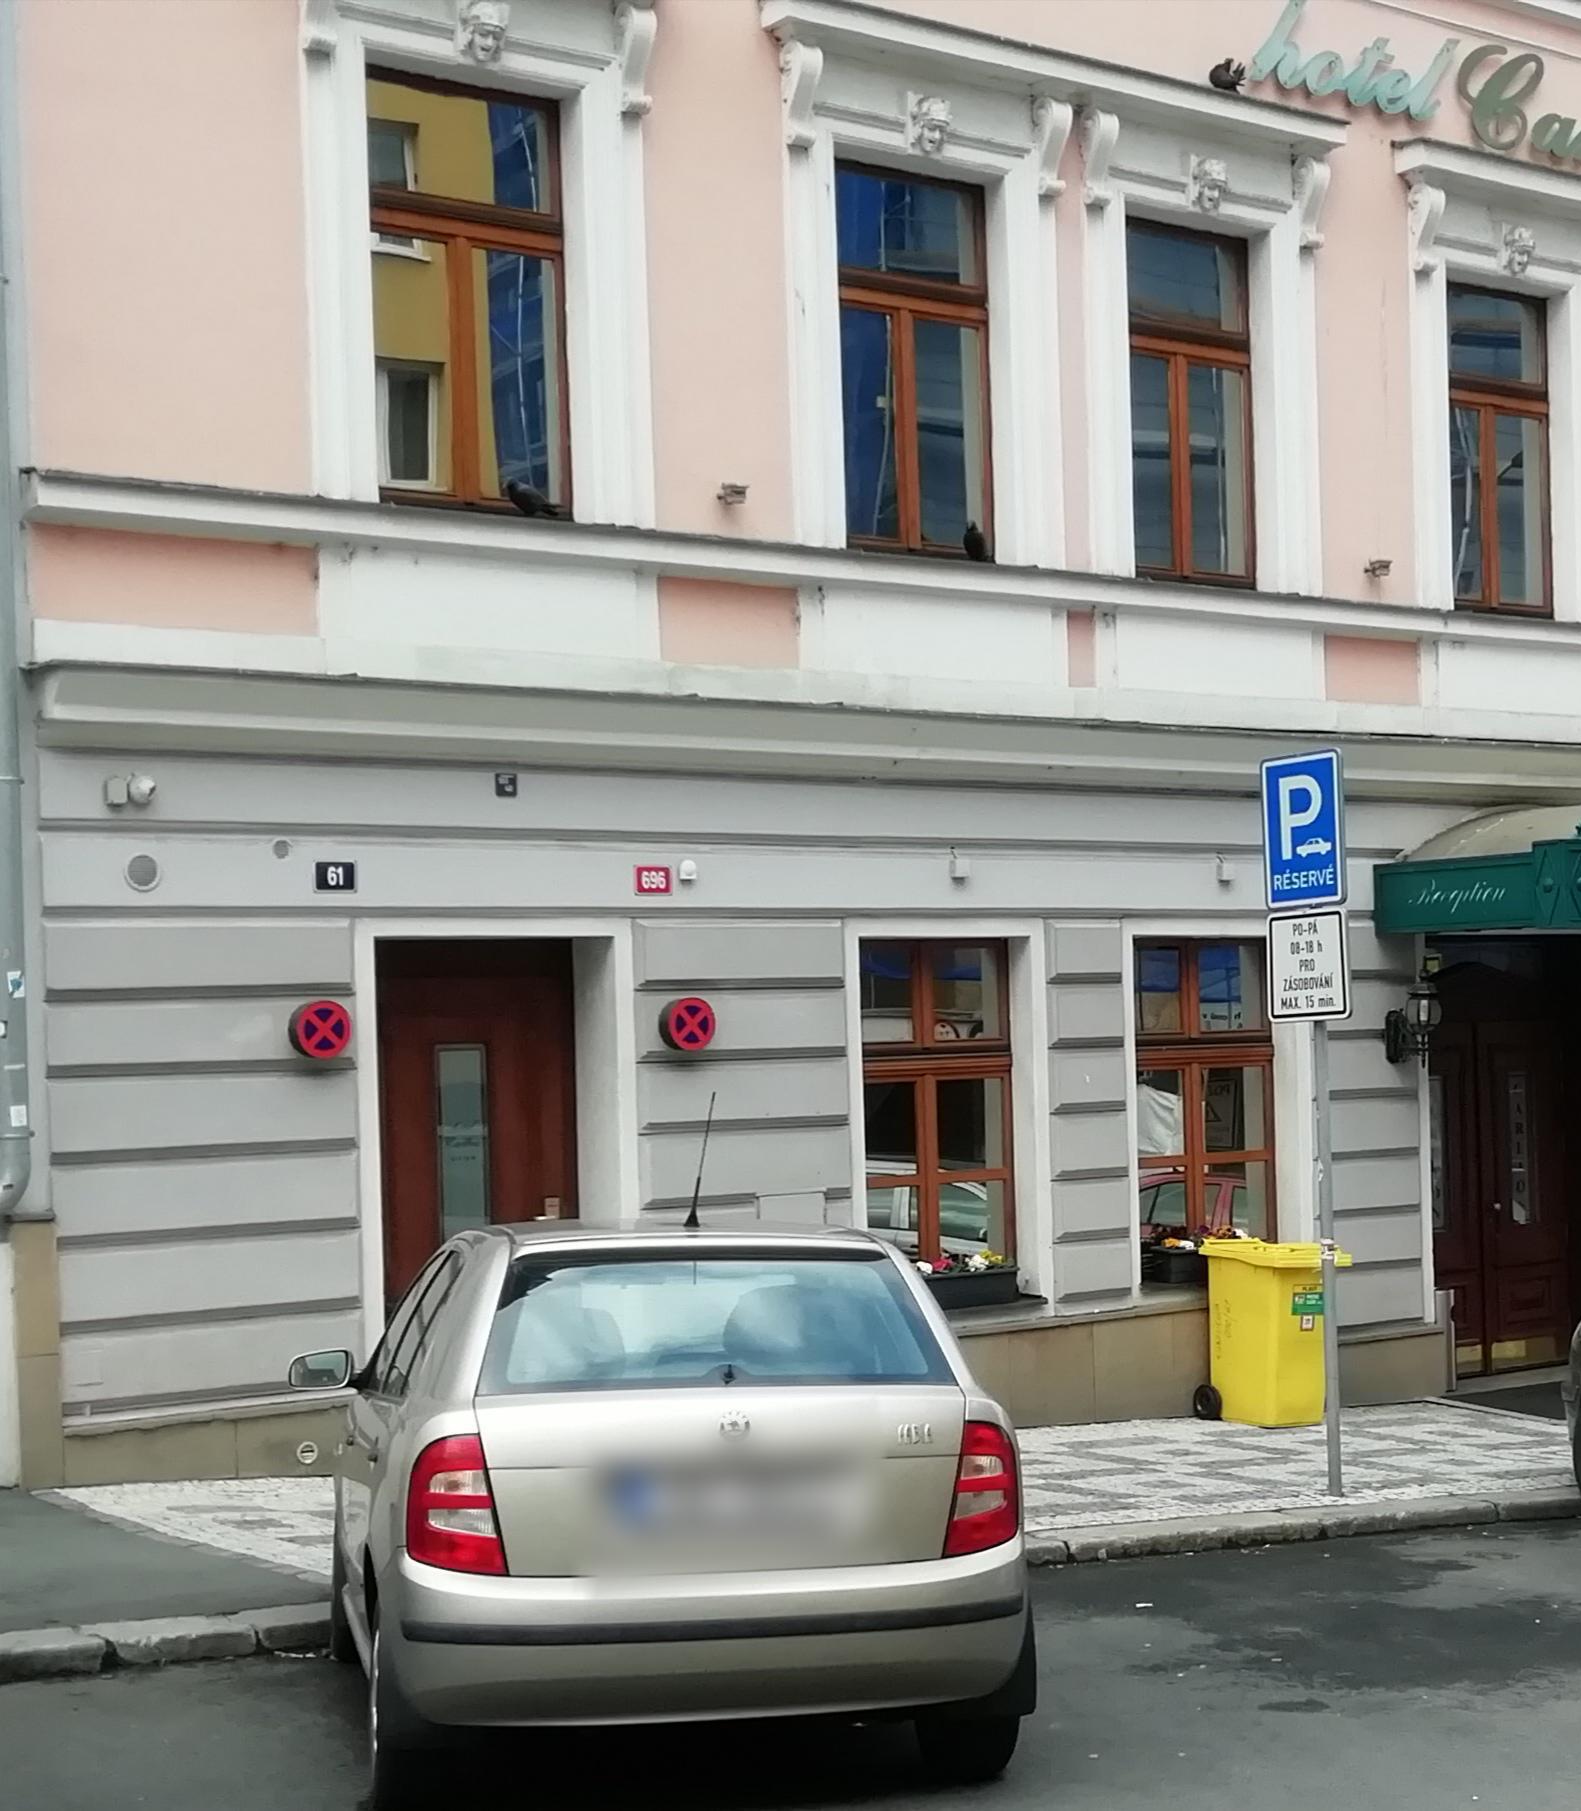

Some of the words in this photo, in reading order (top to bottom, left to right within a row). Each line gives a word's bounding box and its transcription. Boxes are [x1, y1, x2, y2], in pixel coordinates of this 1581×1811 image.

[1249, 0, 1460, 121] hotel
[1278, 774, 1322, 860] P
[326, 866, 344, 886] 61
[641, 870, 666, 890] 696
[1273, 865, 1335, 890] RÉSERVÉ
[1292, 920, 1319, 937] PO-PÁ
[1290, 941, 1314, 955] 08-18
[1316, 940, 1323, 953] h
[1299, 958, 1315, 972] PRO
[1283, 973, 1334, 992] ZÁSOBOVÁNÍ
[1280, 996, 1302, 1011] MAX.
[1305, 994, 1315, 1008] 15
[1318, 993, 1337, 1007] min.
